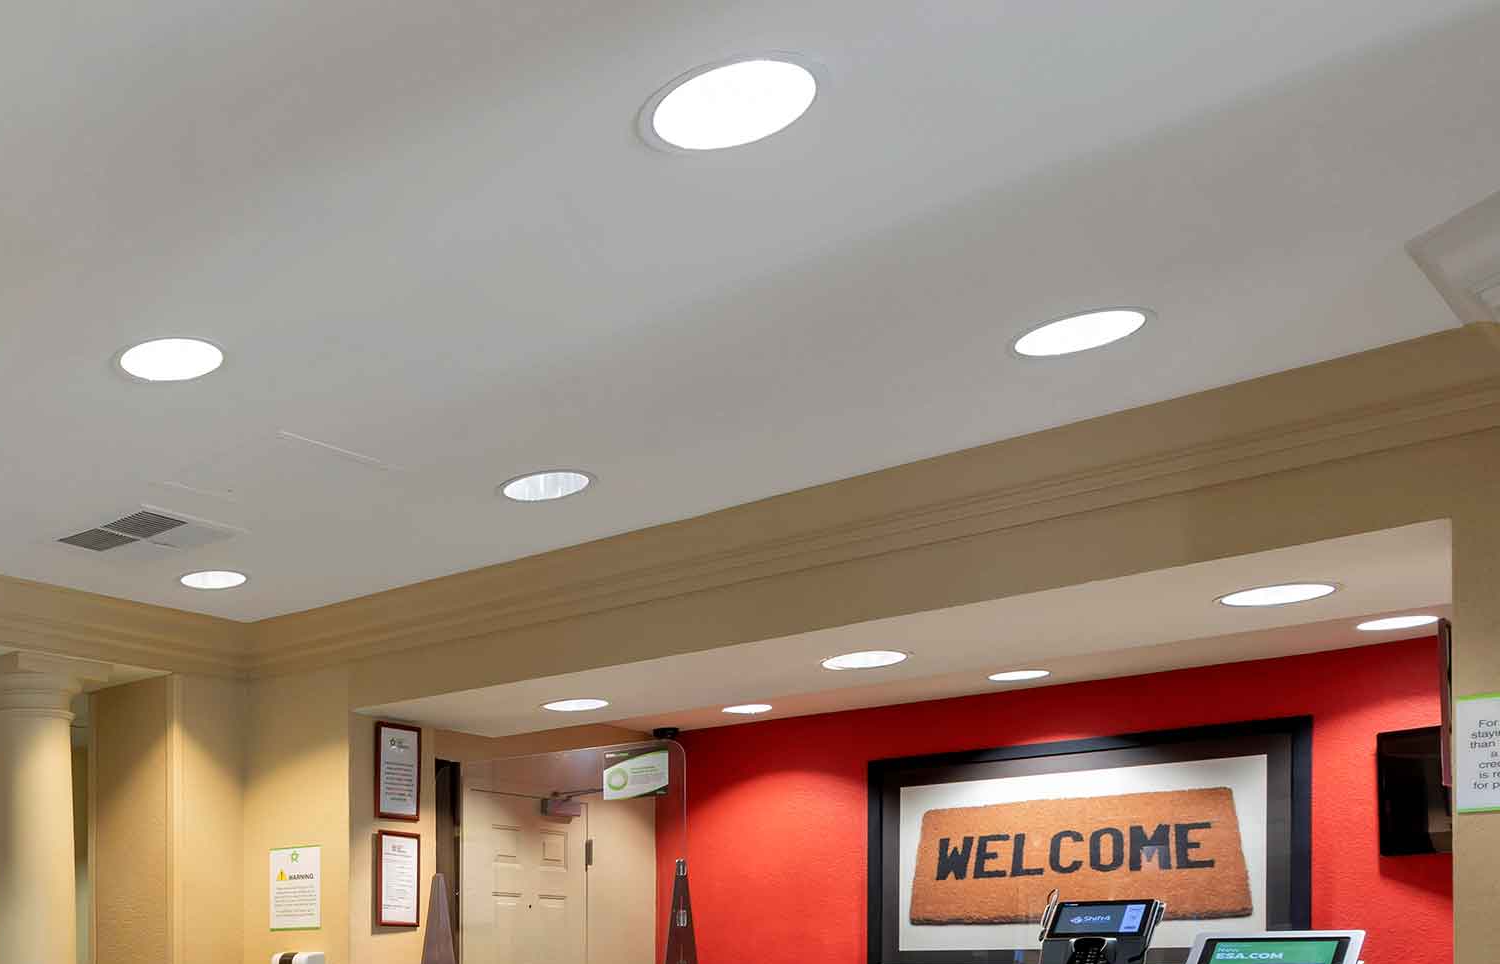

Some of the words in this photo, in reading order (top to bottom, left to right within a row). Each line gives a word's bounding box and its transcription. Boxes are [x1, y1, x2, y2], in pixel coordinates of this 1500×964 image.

[1478, 719, 1498, 728] For
[1470, 740, 1496, 750] than
[936, 822, 1216, 880] WELCOME
[1215, 952, 1284, 960] ESA.COM
